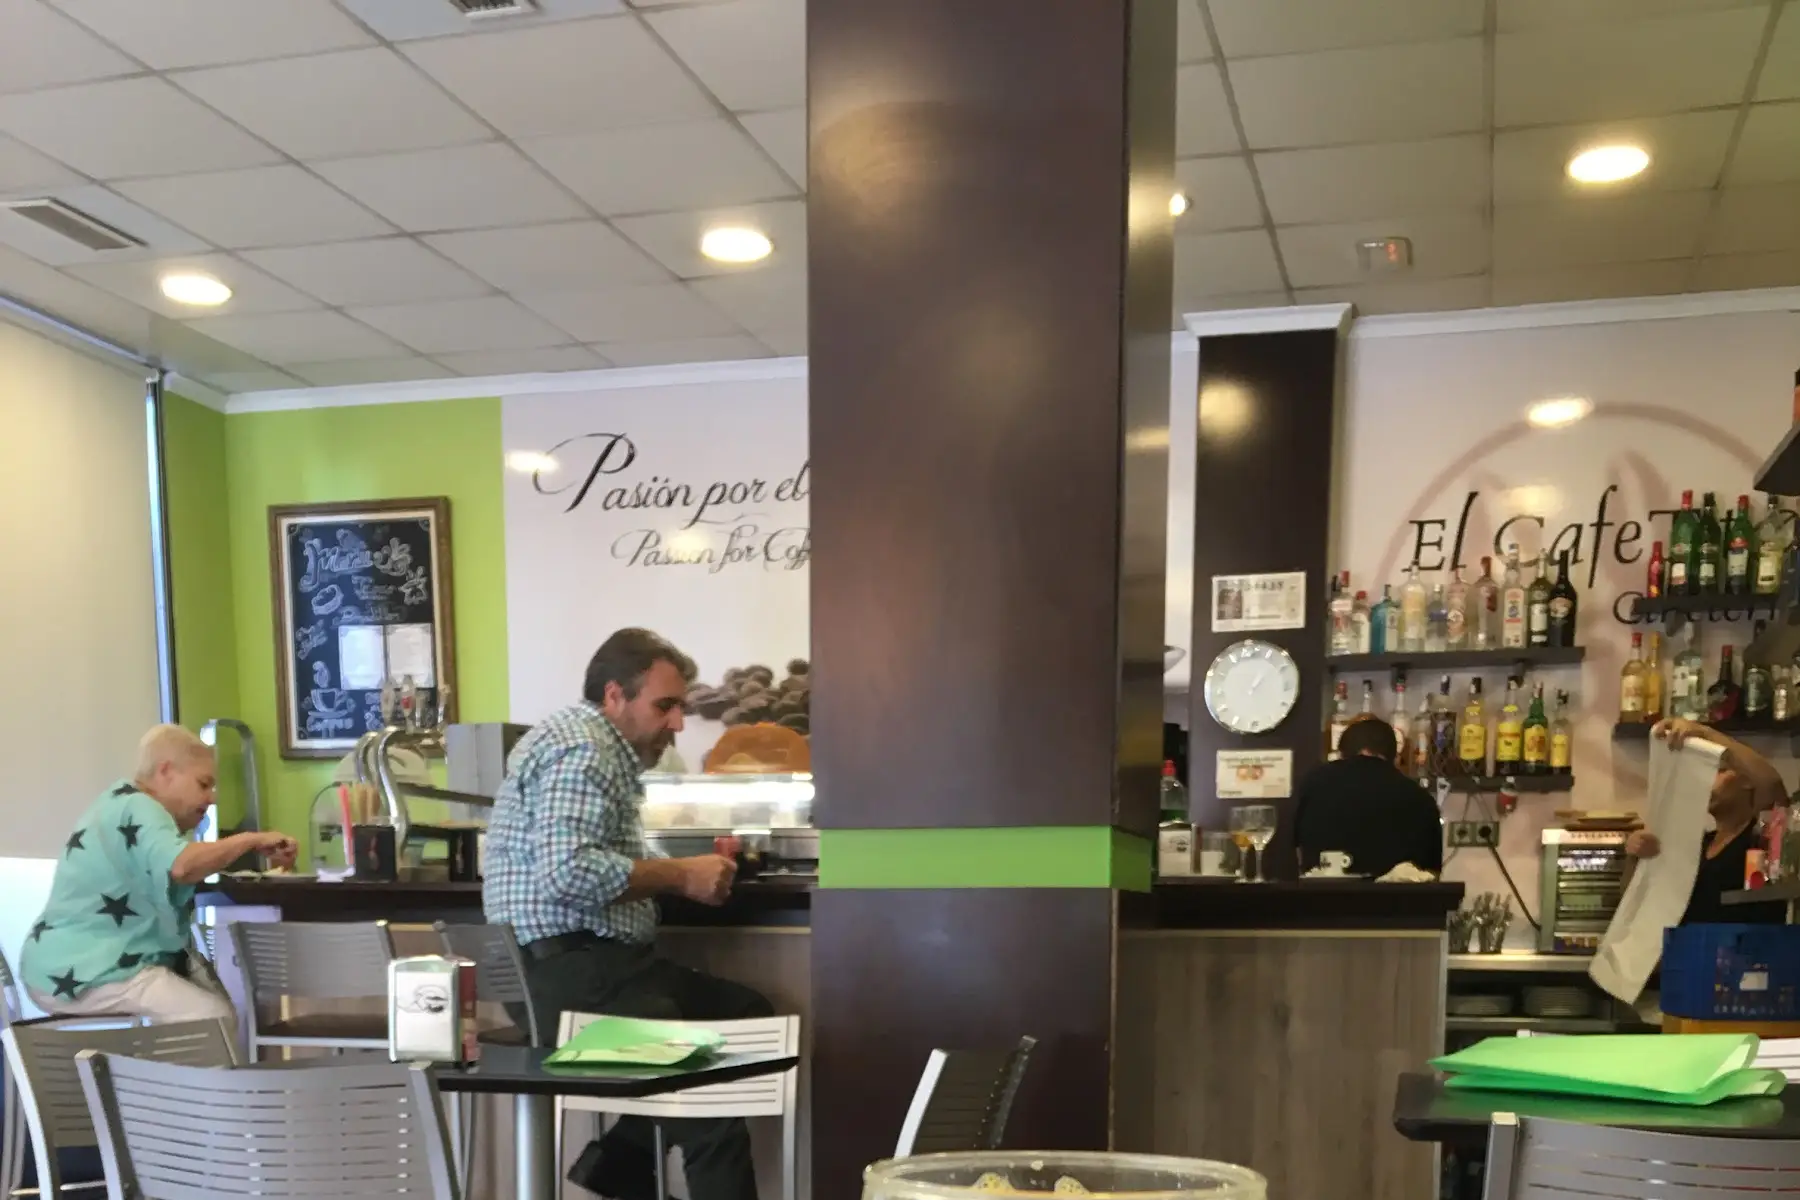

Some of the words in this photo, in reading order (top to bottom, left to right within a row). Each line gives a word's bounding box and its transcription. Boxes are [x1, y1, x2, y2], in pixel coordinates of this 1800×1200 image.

[531, 432, 692, 513] Pasión
[681, 474, 768, 530] por
[774, 457, 810, 501] el
[1402, 491, 1479, 573] El
